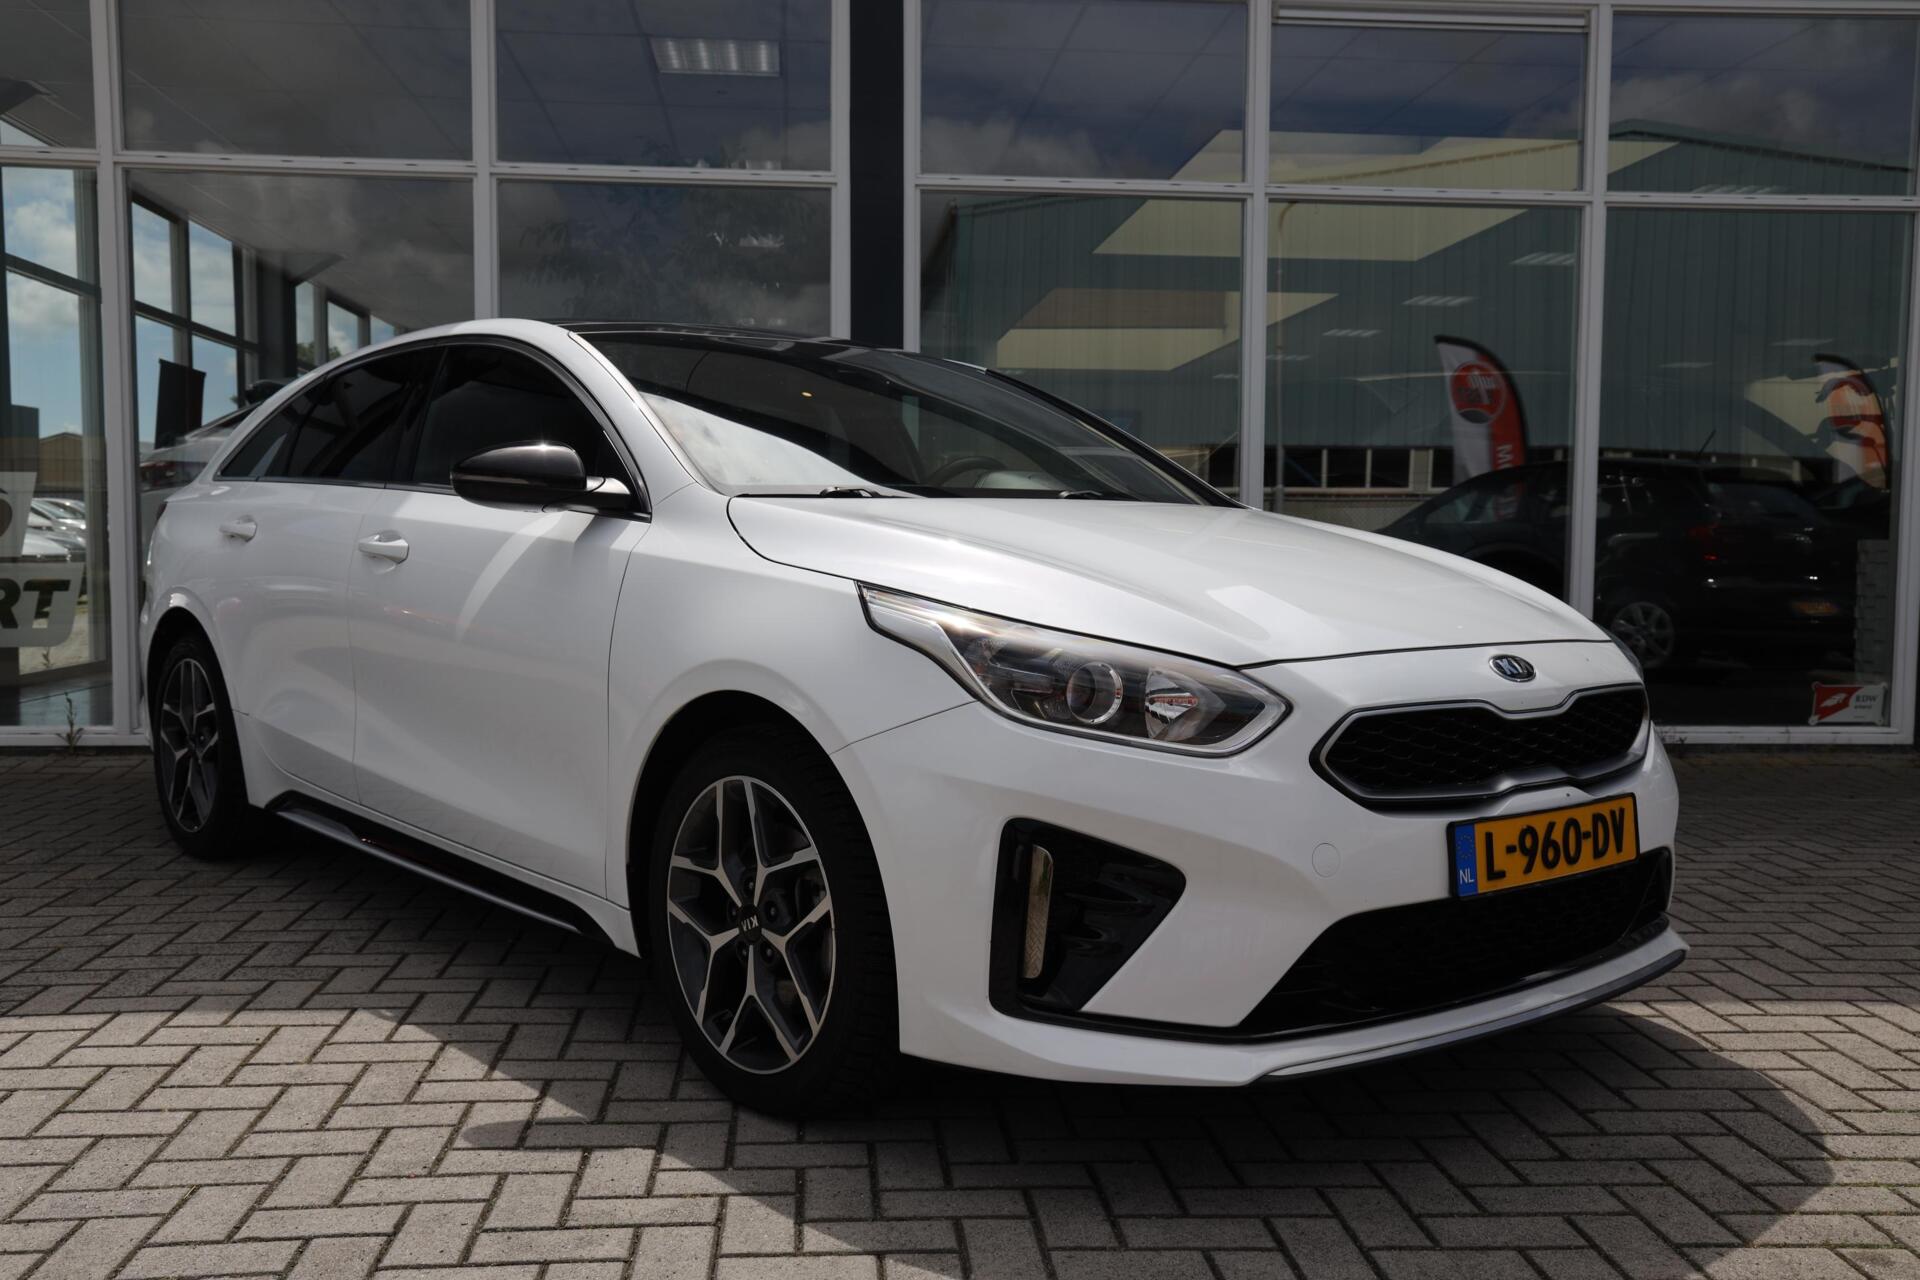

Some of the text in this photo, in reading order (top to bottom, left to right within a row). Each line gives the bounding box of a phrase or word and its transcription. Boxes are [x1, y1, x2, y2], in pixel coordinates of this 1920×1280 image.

[1493, 656, 1534, 676] KIA
[1485, 807, 1625, 881] L-960-DV
[1459, 869, 1475, 885] NL
[740, 914, 759, 932] KIA
